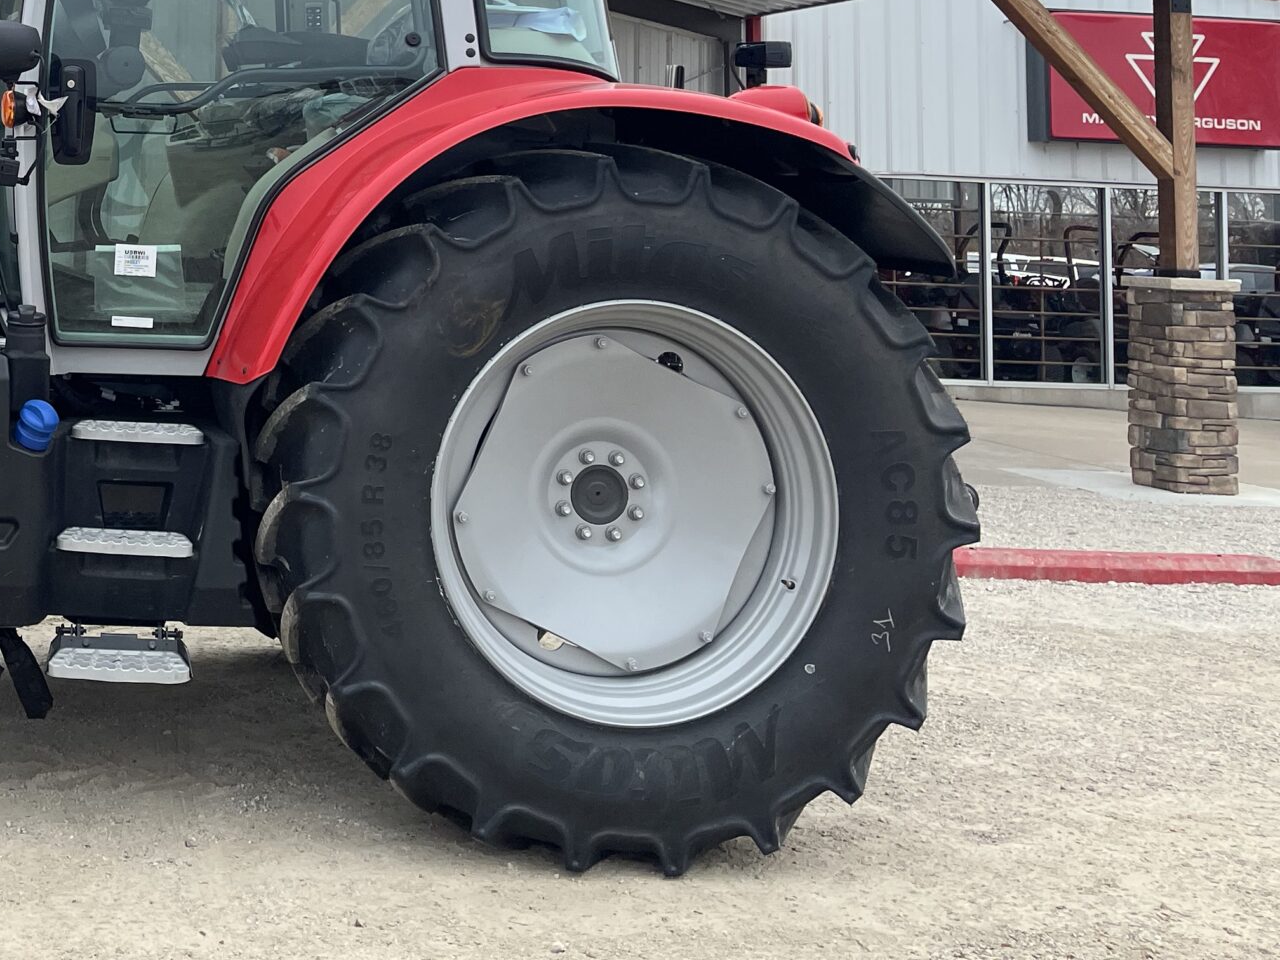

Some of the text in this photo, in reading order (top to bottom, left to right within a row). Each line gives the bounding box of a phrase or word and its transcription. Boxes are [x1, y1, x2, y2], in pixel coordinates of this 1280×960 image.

[363, 432, 393, 474] 38
[360, 484, 385, 506] R
[871, 429, 919, 562] AC85
